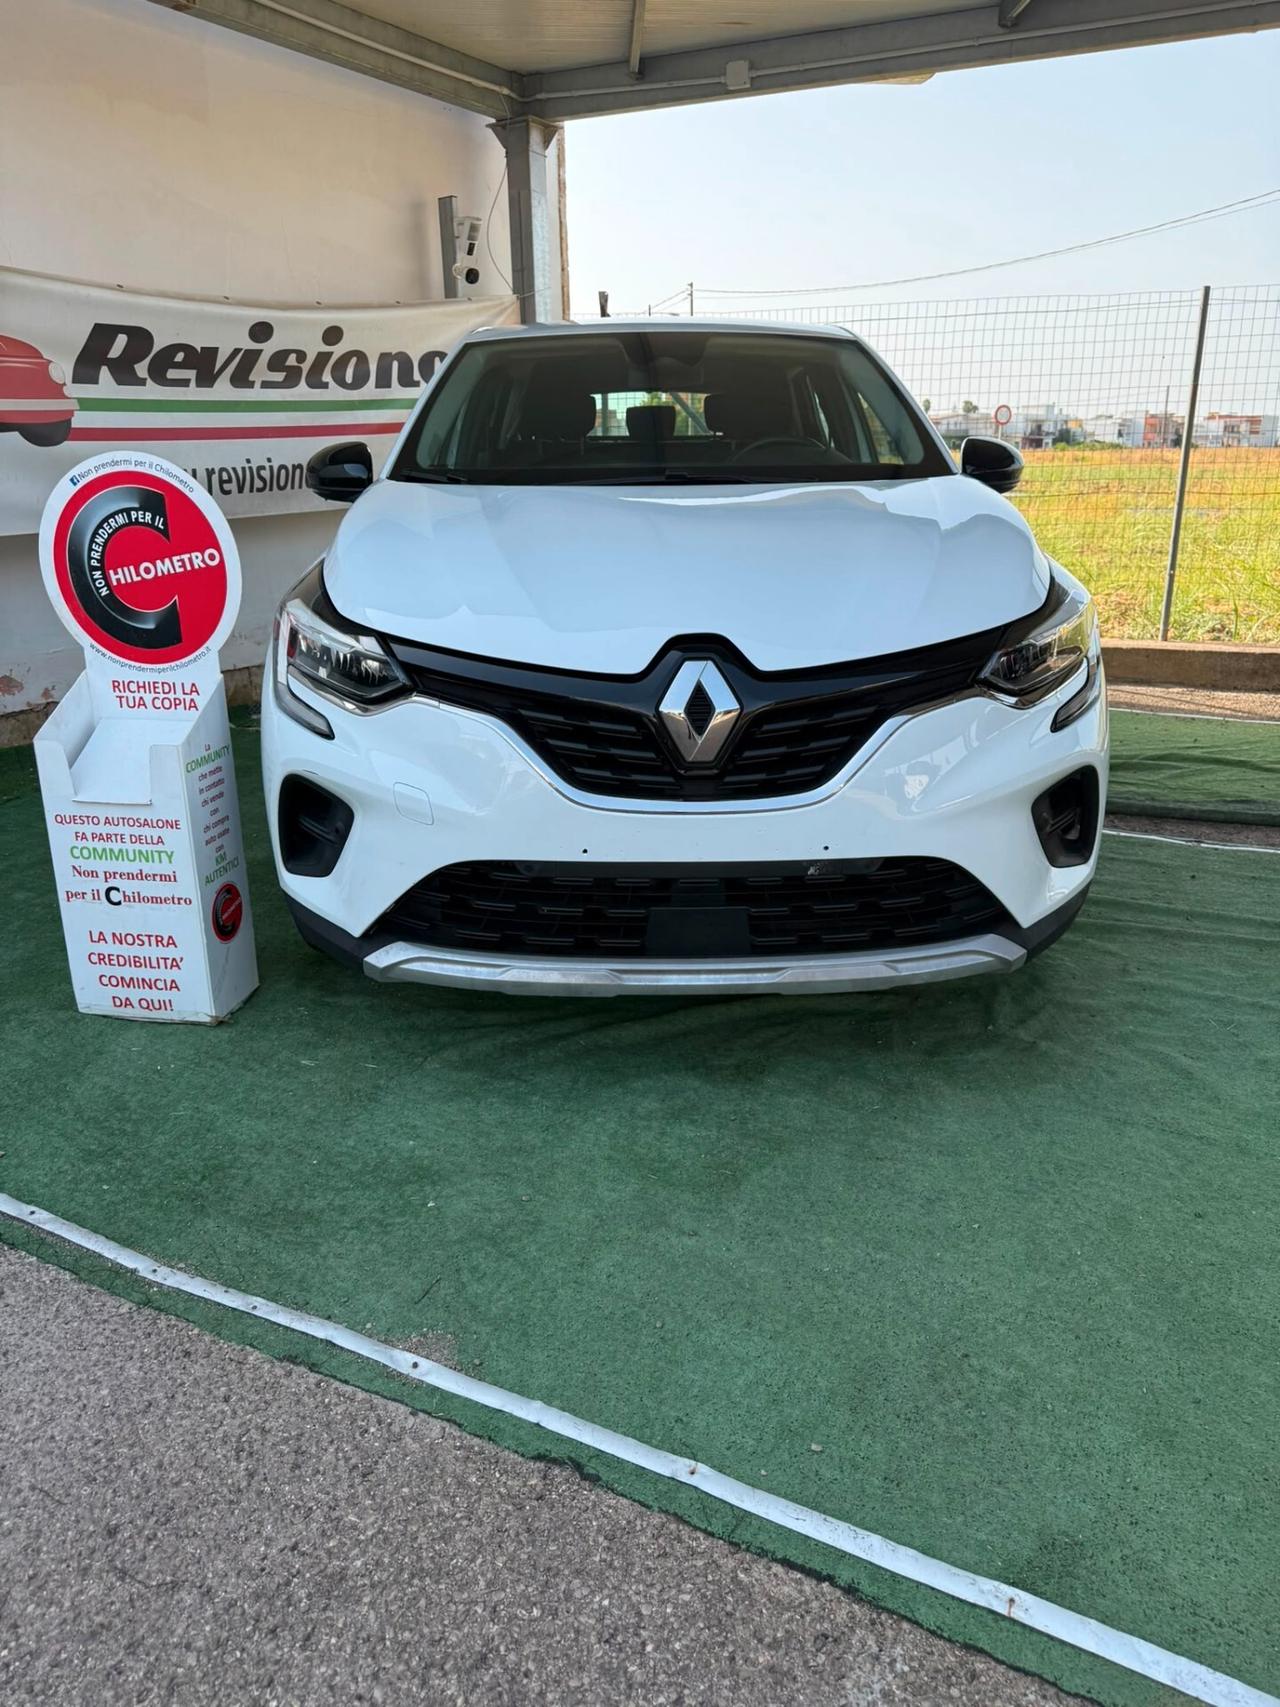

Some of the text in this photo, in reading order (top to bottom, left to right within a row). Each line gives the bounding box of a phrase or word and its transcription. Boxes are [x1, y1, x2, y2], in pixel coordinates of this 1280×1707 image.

[78, 467, 94, 481] Non
[94, 457, 132, 473] prendermi
[134, 459, 147, 468] per
[148, 460, 154, 469] il
[154, 463, 194, 493] Chilometro
[91, 510, 165, 597] NON PRENDERMI PER IL
[112, 680, 200, 696] RICHIEDI LA
[116, 695, 199, 712] TUA COPIA
[185, 744, 230, 773] COMMUNITY
[54, 813, 181, 830] QUESTO AUTOSALONE
[74, 831, 165, 846] FA PARTE DELLA
[69, 845, 175, 864] COMMUNITY
[71, 865, 178, 882] Non prendermi
[65, 890, 87, 902] per
[91, 889, 102, 901] il
[89, 929, 178, 949] LA NOSTRA
[88, 951, 184, 970] CREDIBILITA'
[98, 974, 181, 992] COMINCIA
[112, 995, 174, 1012] DA QUI!
